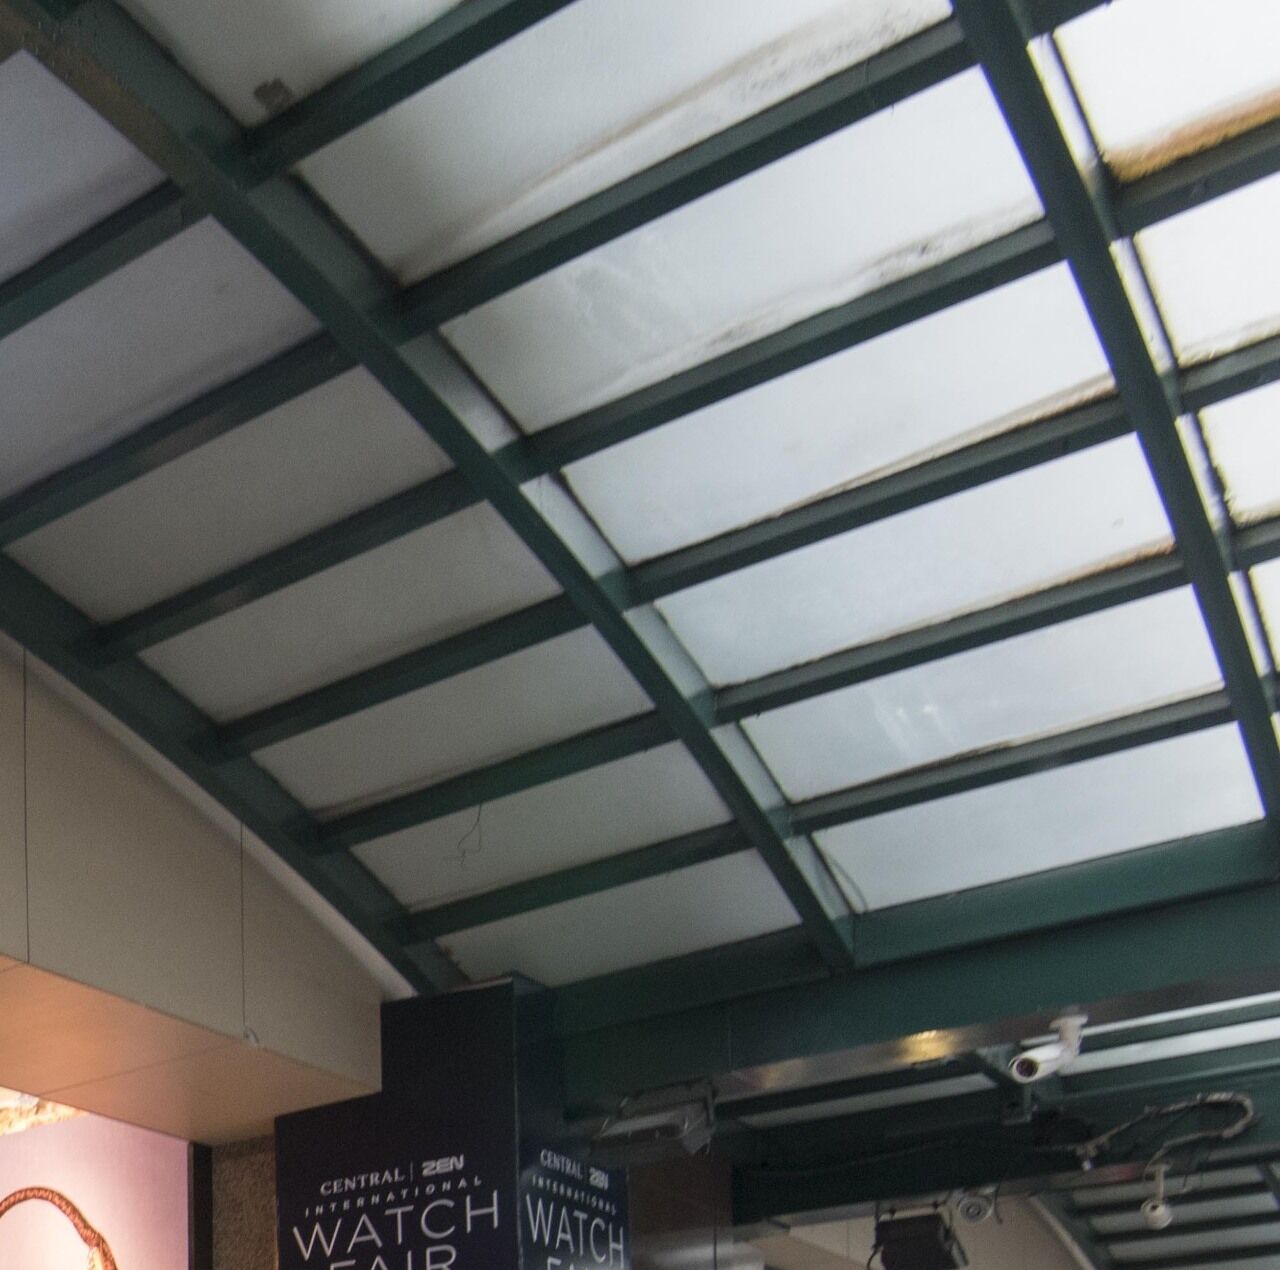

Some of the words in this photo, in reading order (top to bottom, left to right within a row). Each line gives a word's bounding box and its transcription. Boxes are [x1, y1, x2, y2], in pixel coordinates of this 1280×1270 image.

[320, 1168, 405, 1196] CENTRAL
[421, 1154, 465, 1177] ZEN
[540, 1149, 583, 1180] CENTRAL
[304, 1175, 482, 1218] INTERNATIONAL
[293, 1190, 499, 1261] WATCH
[526, 1193, 625, 1269] WATCH
